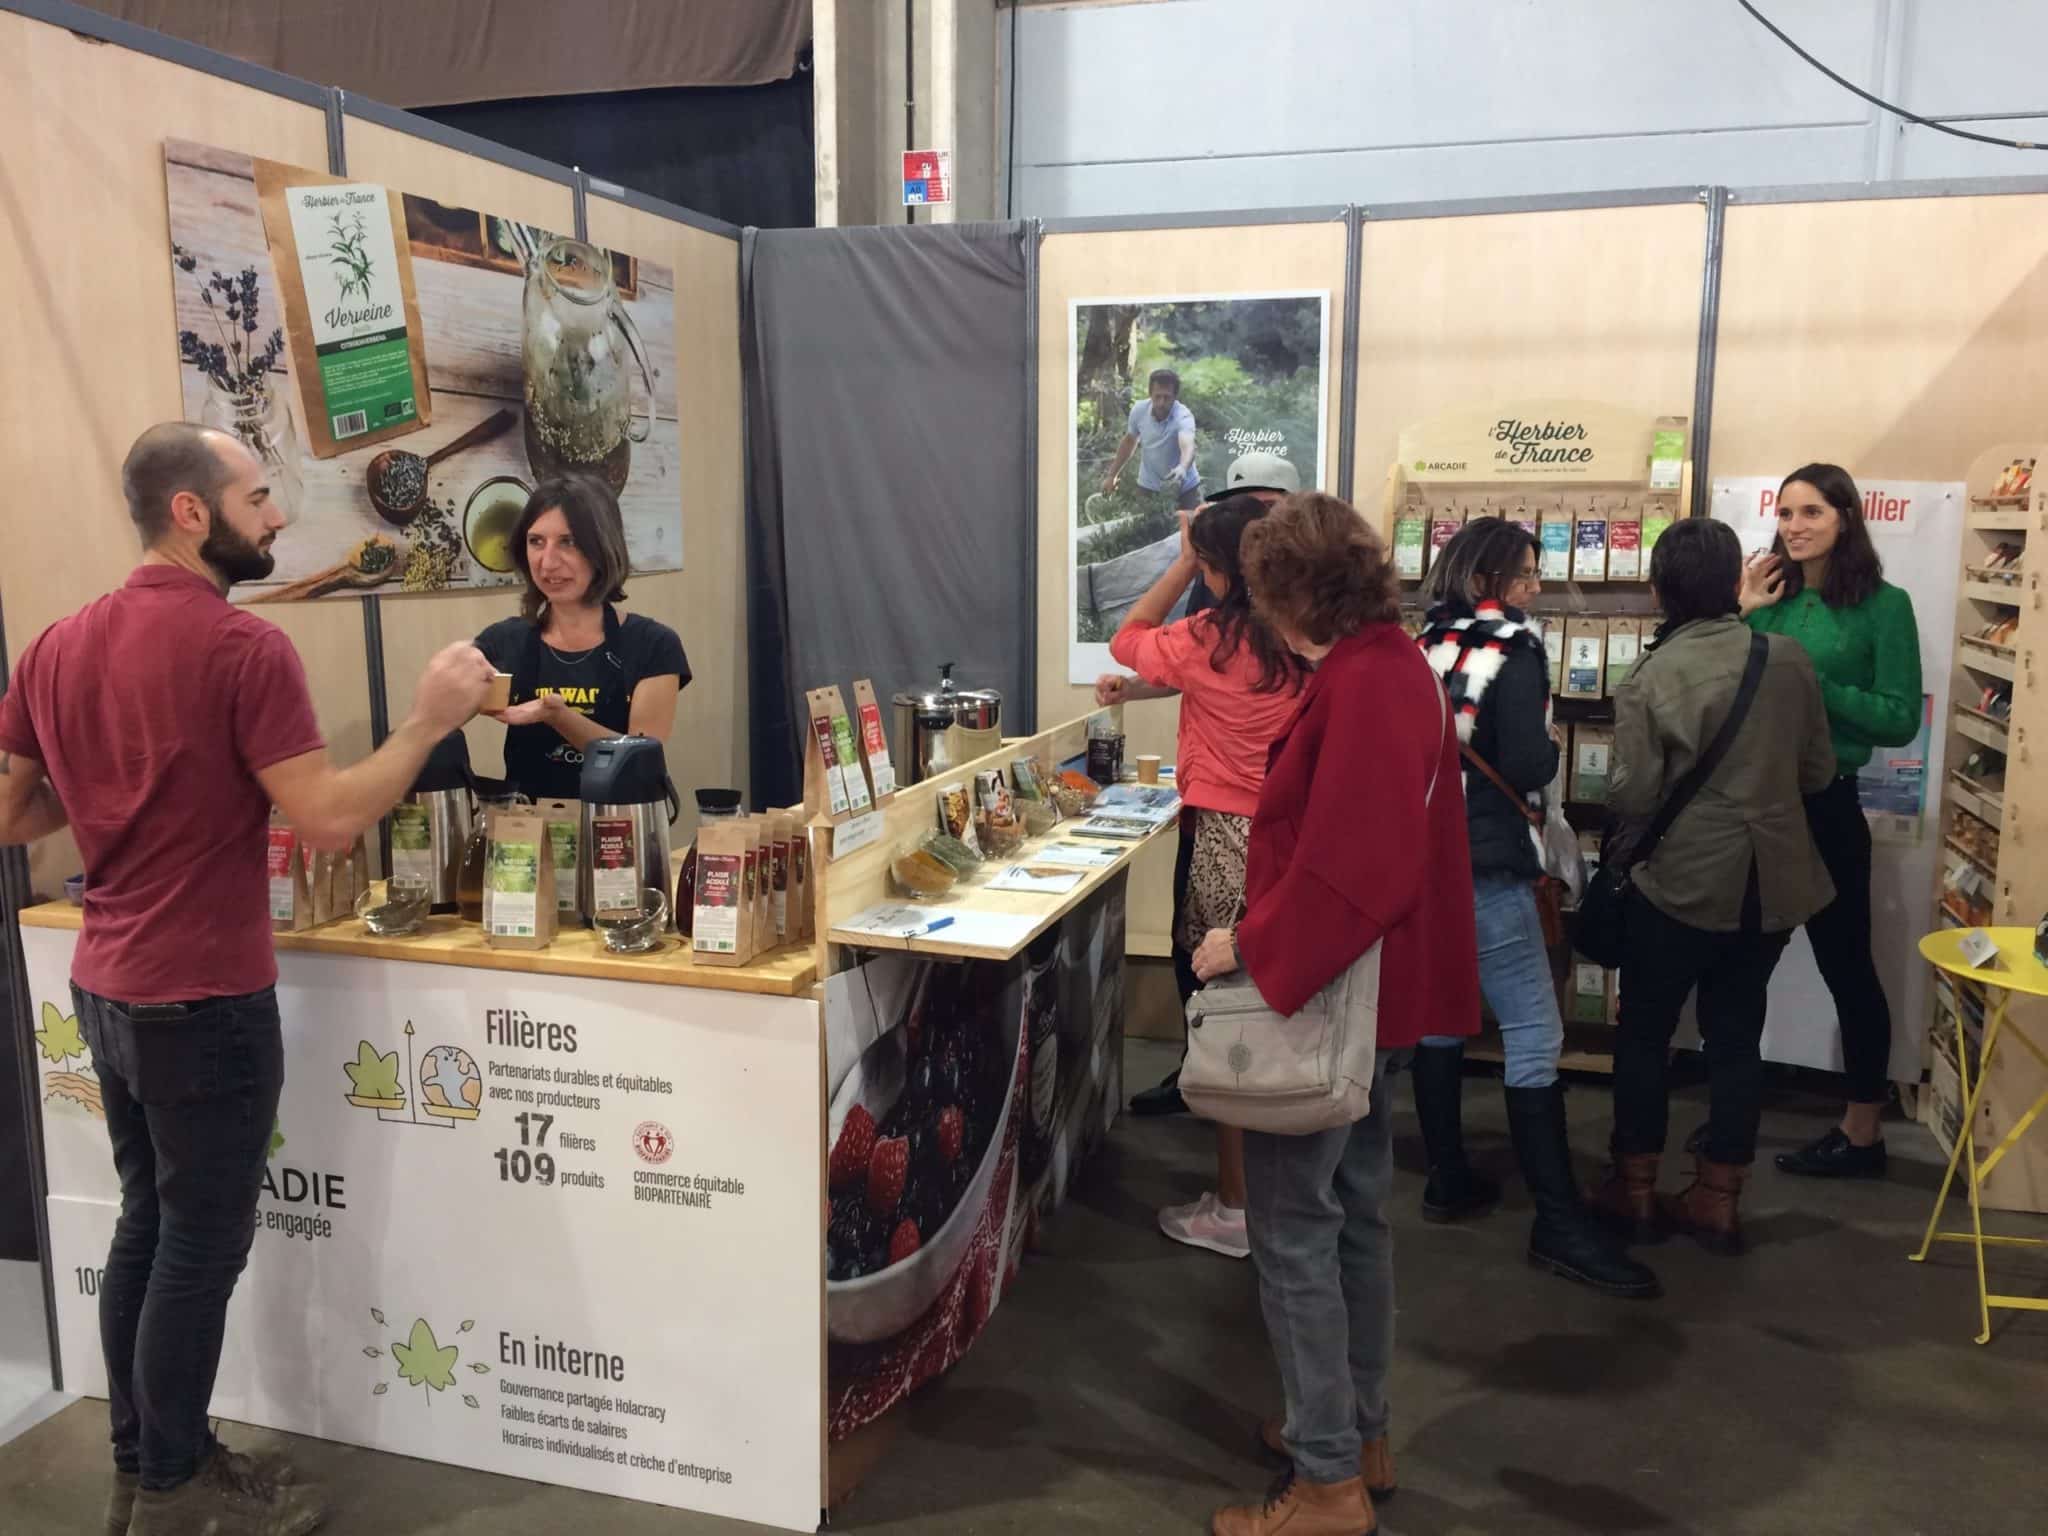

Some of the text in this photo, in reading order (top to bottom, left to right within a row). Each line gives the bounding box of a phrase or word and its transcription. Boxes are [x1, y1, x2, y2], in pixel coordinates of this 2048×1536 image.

[324, 303, 393, 328] Verveine
[1427, 461, 1467, 472] ARCADIE
[1510, 441, 1594, 465] France
[1864, 490, 1911, 521] ilier
[564, 750, 585, 763] Co
[486, 1009, 577, 1053] Filières
[488, 1061, 673, 1095] Partenariats durables et équitables
[489, 1085, 600, 1110] avec nos producteurs
[514, 1111, 596, 1152] 17 filières
[494, 1147, 605, 1190] 109 produits
[633, 1169, 745, 1195] commerce équitable
[260, 1166, 346, 1209] ADIE
[634, 1185, 712, 1209] BIOPARTENAIRE
[266, 1209, 332, 1241] engagée
[499, 1331, 624, 1382] En interne
[500, 1378, 666, 1423] Gouvernance partagée Holacracy
[501, 1404, 627, 1440] Faibles écarts de salaires
[502, 1429, 732, 1485] Horaires individualisés et crèche d'entreprise
